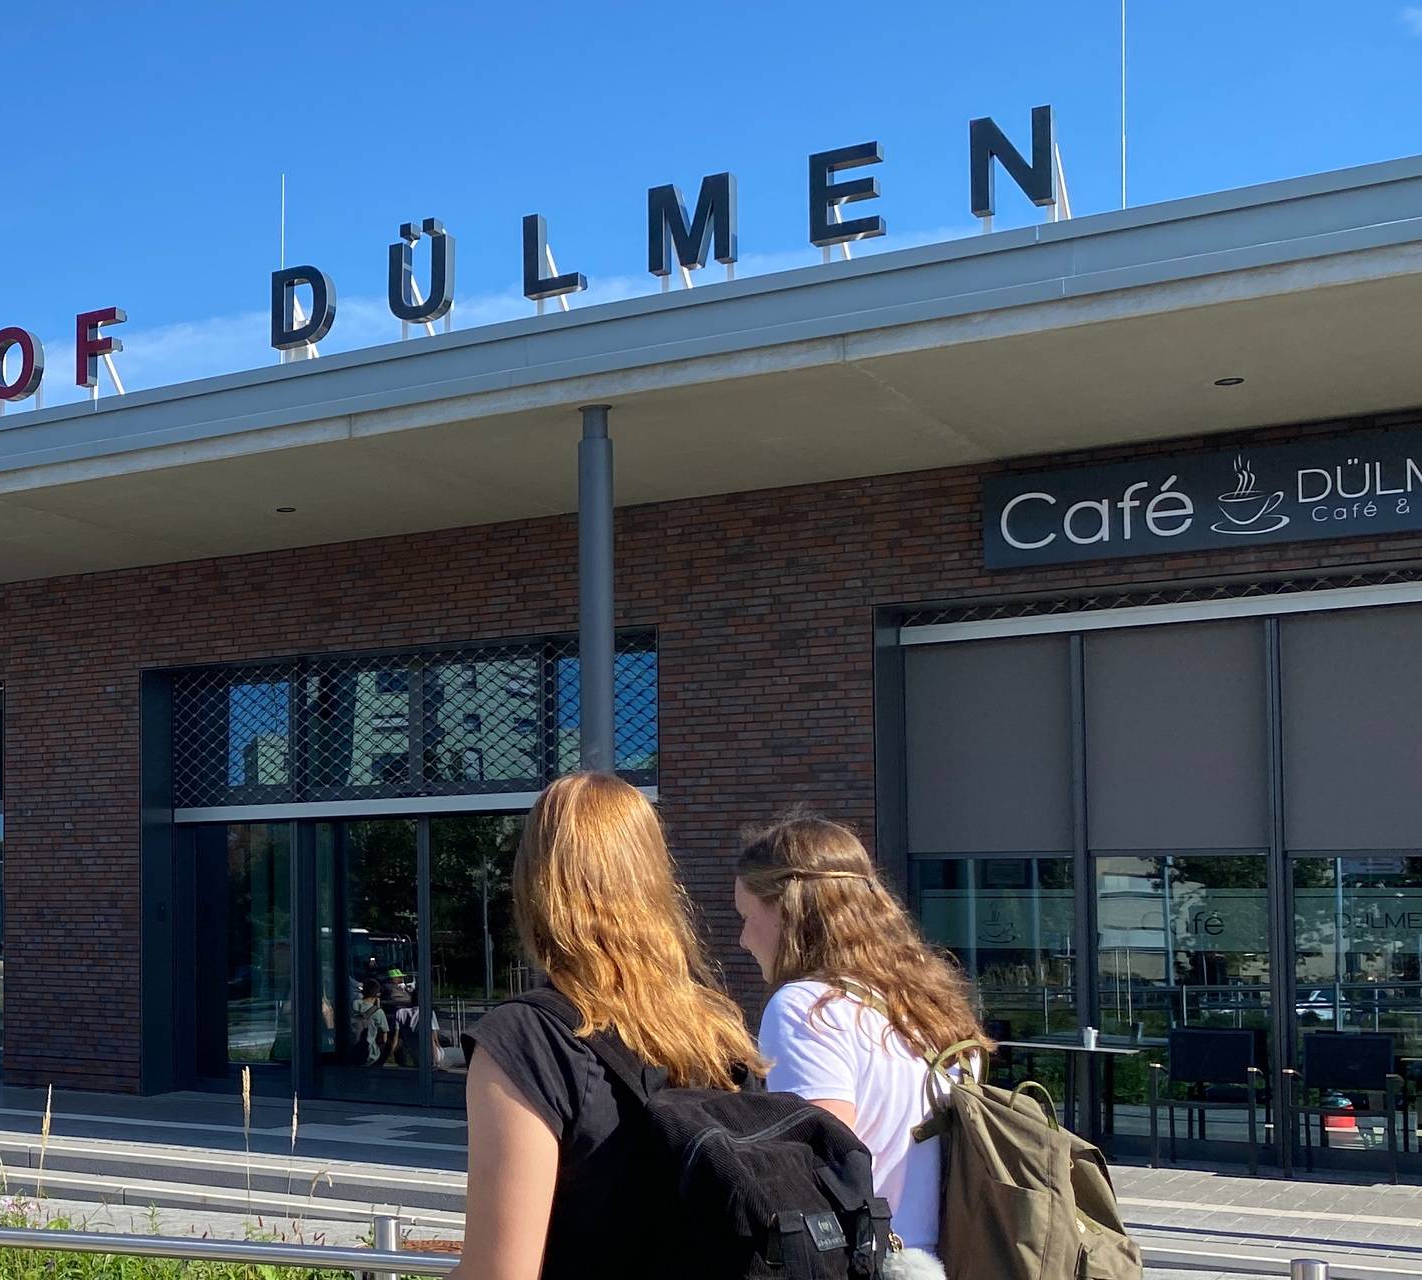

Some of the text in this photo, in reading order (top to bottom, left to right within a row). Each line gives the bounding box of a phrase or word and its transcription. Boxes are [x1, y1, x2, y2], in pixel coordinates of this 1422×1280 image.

[271, 105, 1057, 350] DÜLMEN
[1000, 475, 1194, 549] Café
[1312, 498, 1410, 521] Café &
